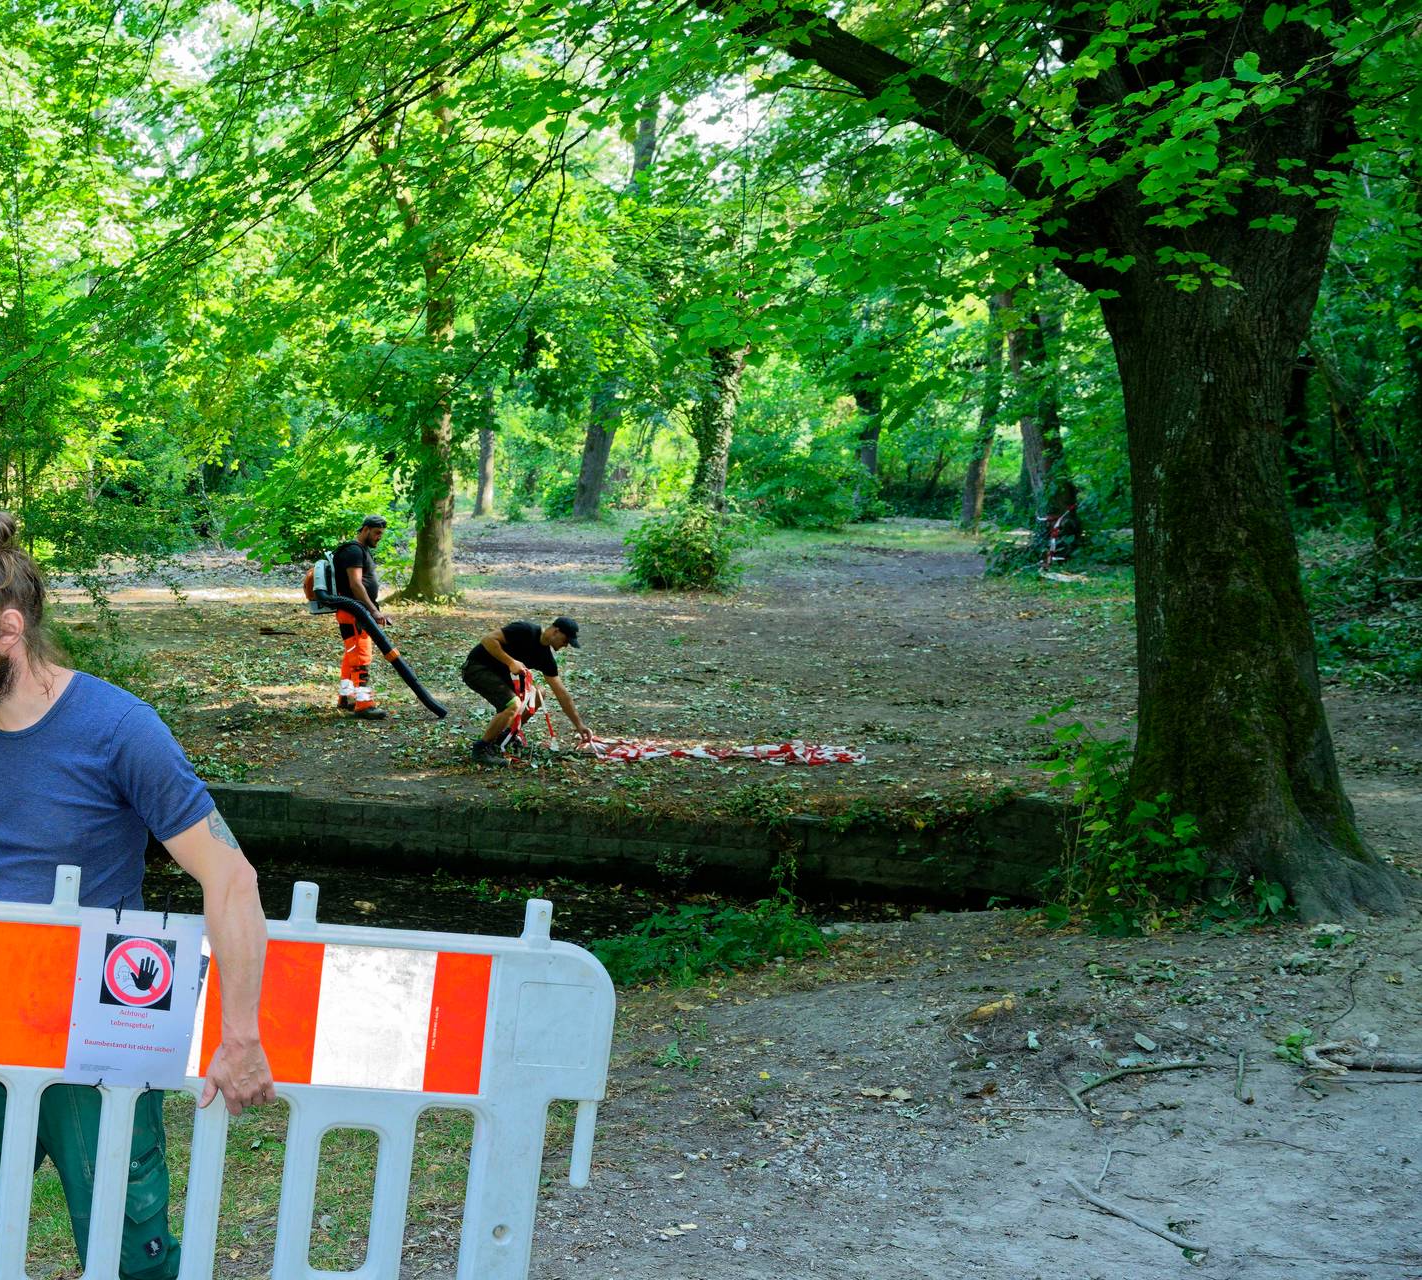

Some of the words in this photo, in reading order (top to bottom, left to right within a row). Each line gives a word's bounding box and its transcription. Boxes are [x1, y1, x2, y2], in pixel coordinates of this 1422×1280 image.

[119, 1009, 148, 1018] Achtung!
[110, 1019, 155, 1030] Lebensgefahr!
[84, 1039, 128, 1049] Baumbestand
